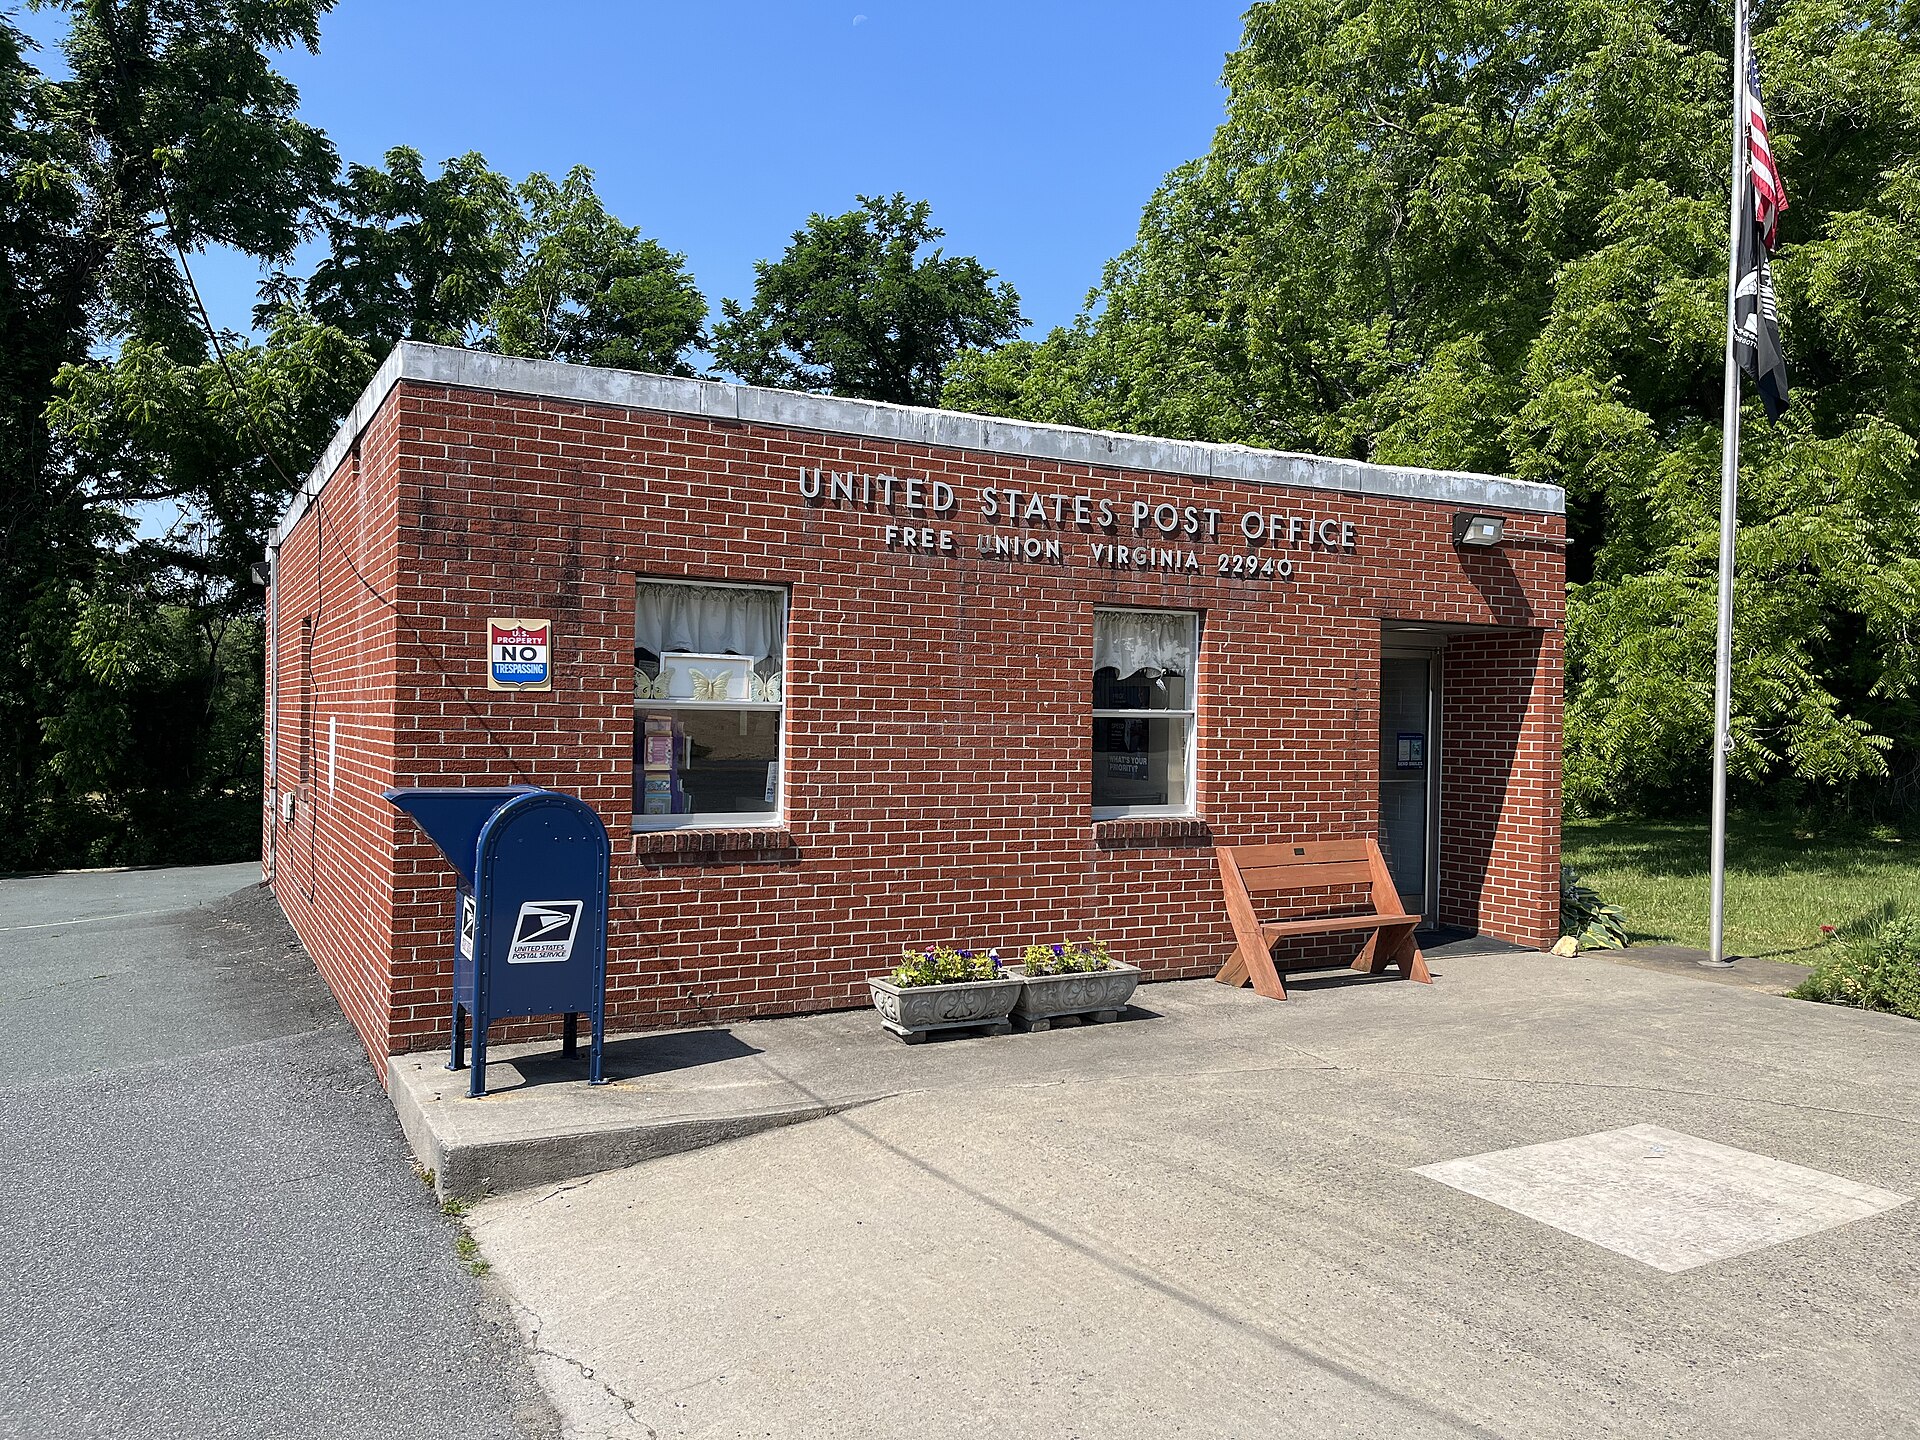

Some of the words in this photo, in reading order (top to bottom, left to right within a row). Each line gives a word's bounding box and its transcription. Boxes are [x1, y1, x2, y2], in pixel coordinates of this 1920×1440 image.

[800, 466, 955, 512] UNITED
[981, 487, 1114, 527] STATES
[1132, 501, 1221, 535] POST
[1241, 512, 1355, 547] OFFICE
[885, 525, 953, 550] FREE
[977, 534, 1060, 559] UNION
[1091, 543, 1199, 569] VIRGINIA
[1218, 554, 1292, 577] 22940
[501, 646, 537, 662] NO
[495, 663, 544, 674] TRESPASSING
[1109, 755, 1131, 764] WHAT'S
[1131, 756, 1148, 765] YOUR
[1109, 763, 1138, 773] PRIORITY?
[514, 945, 541, 953] UNITED
[539, 950, 567, 958] SERVICE
